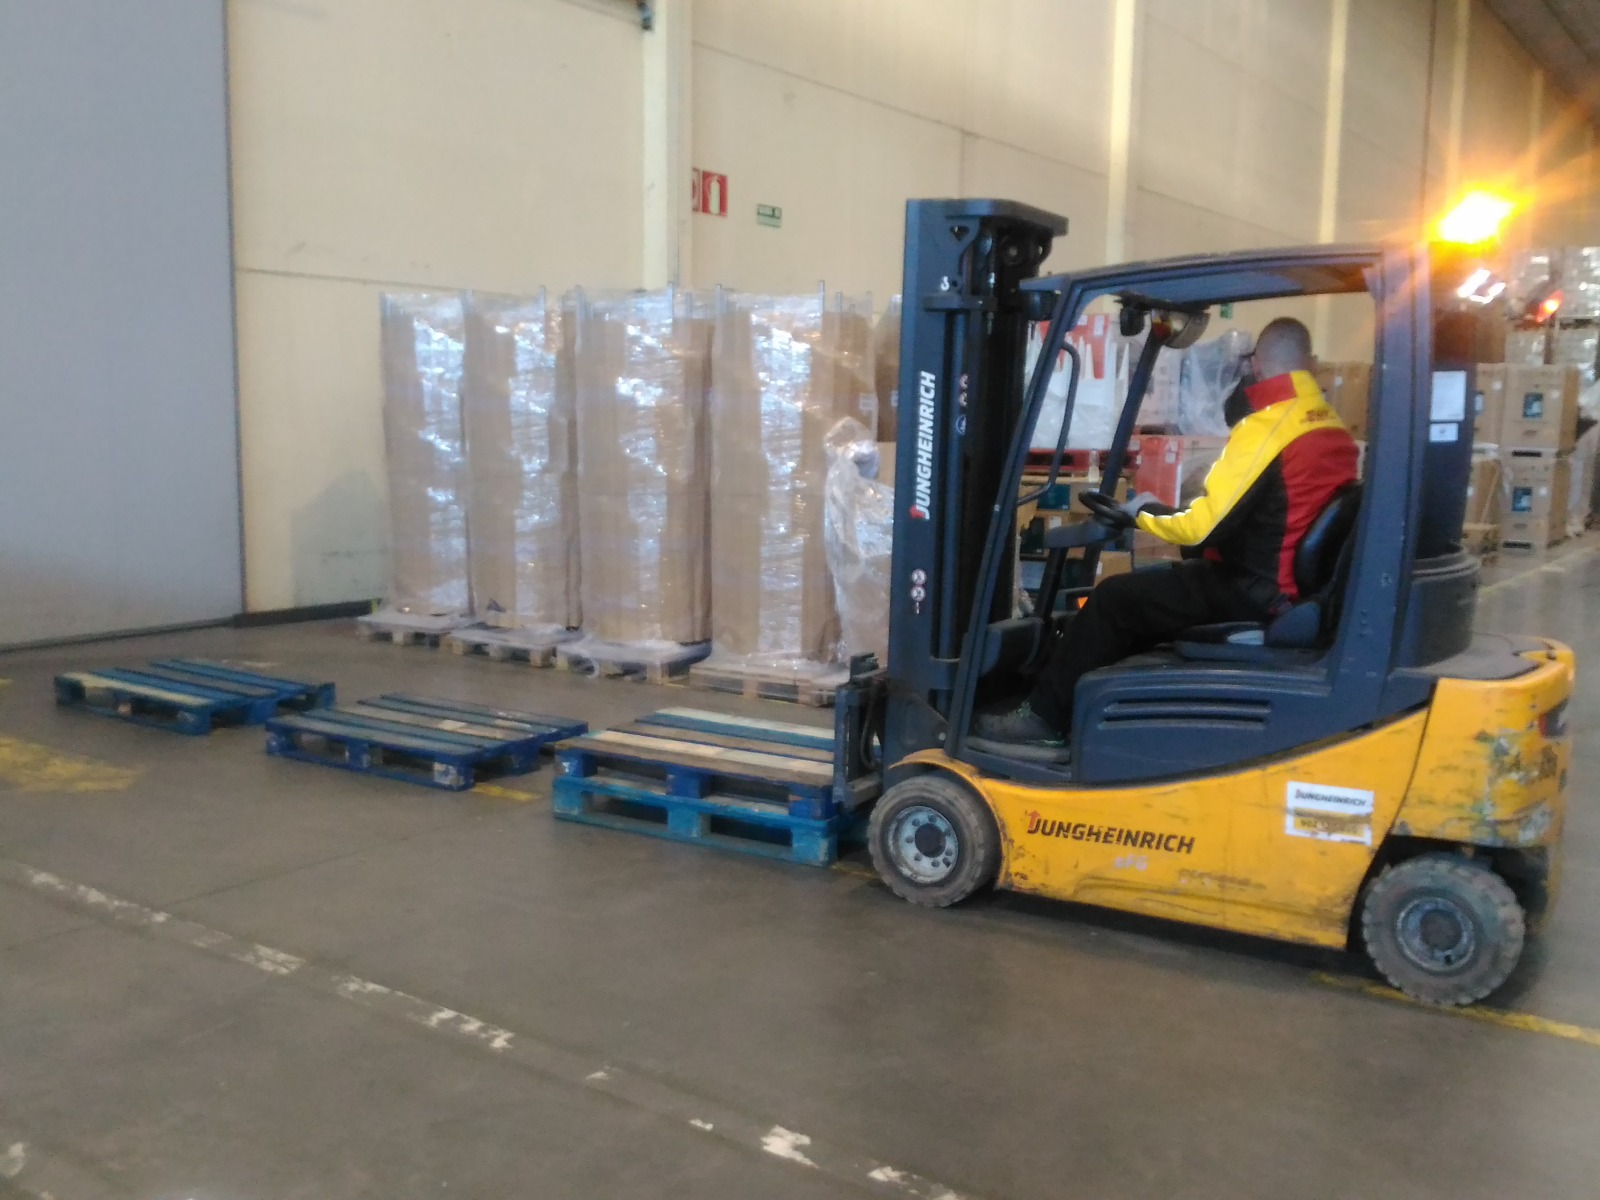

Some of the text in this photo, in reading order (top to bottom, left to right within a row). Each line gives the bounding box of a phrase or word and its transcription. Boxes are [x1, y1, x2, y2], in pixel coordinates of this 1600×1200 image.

[910, 370, 936, 520] JUNGHEINRICH
[1295, 788, 1367, 806] JUNGHEINRICH
[1027, 811, 1196, 854] JUNGHEINRICH
